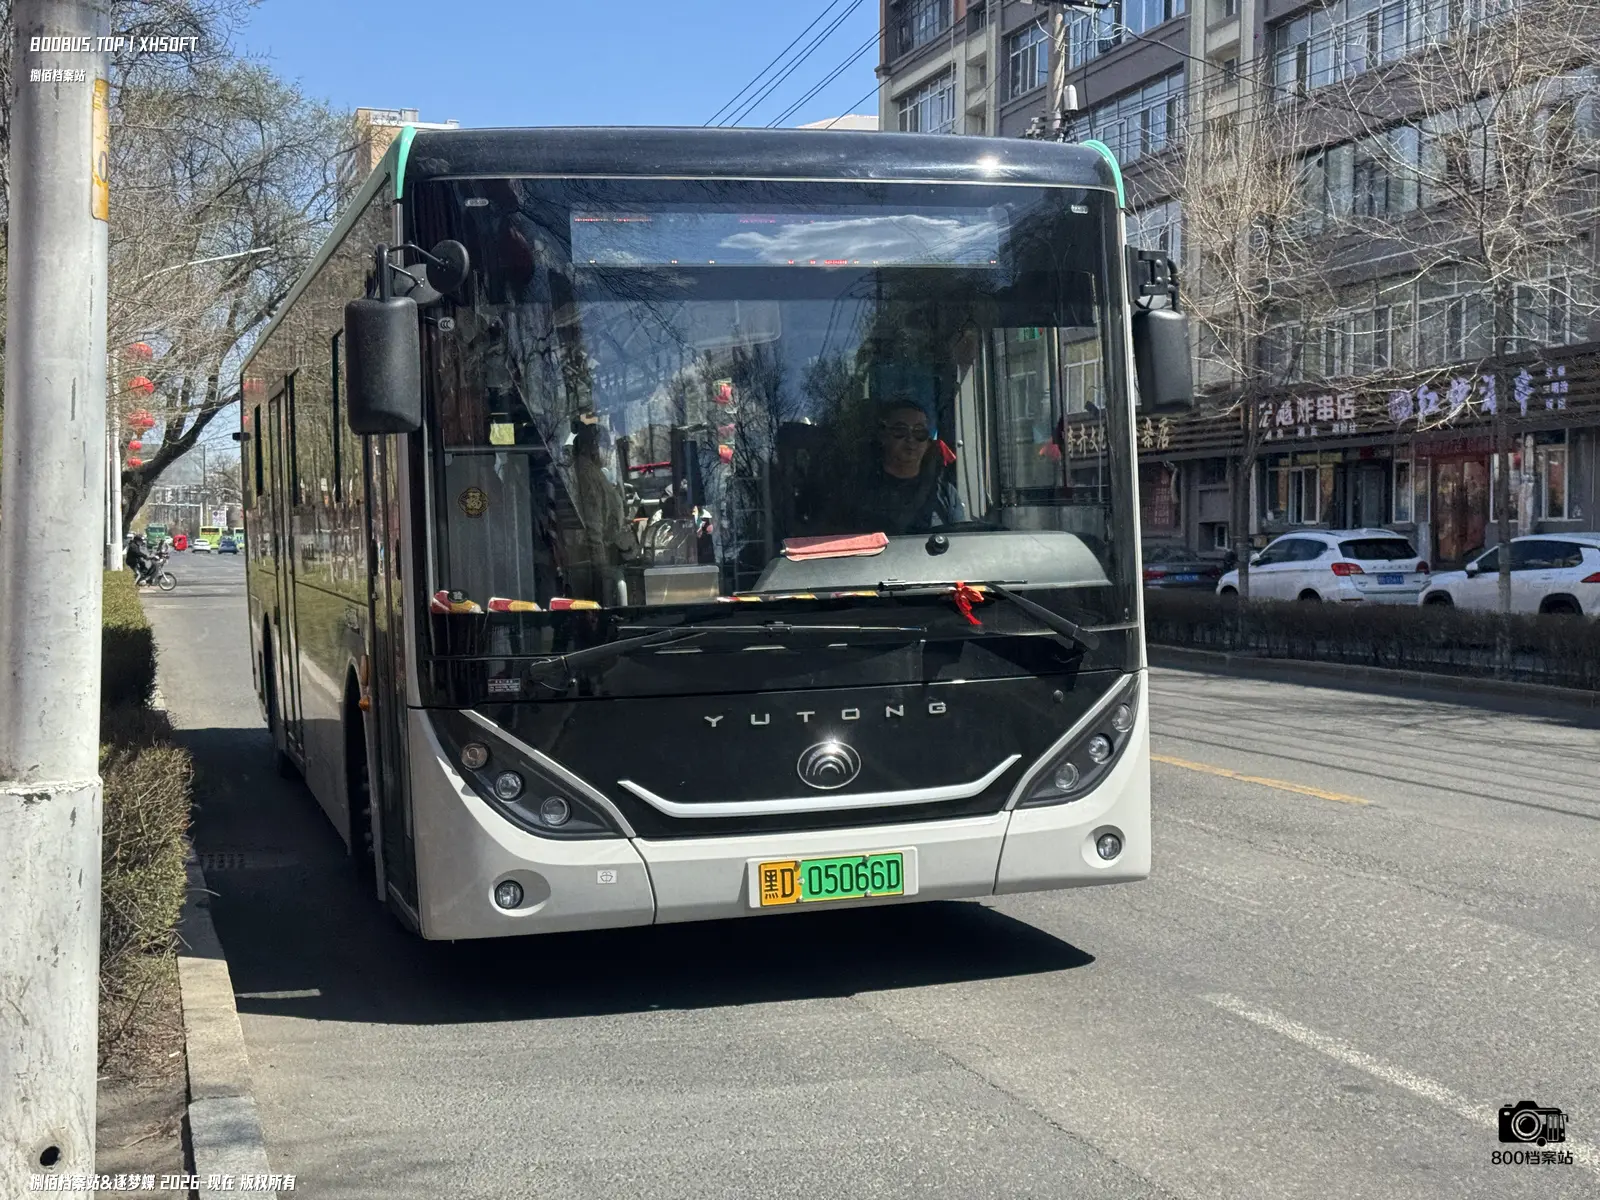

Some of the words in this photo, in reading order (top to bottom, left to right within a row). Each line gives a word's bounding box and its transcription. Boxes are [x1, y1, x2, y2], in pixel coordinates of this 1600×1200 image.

[704, 701, 947, 728] YUTONG
[764, 867, 795, 900] 黑D
[808, 859, 901, 896] 05066D
